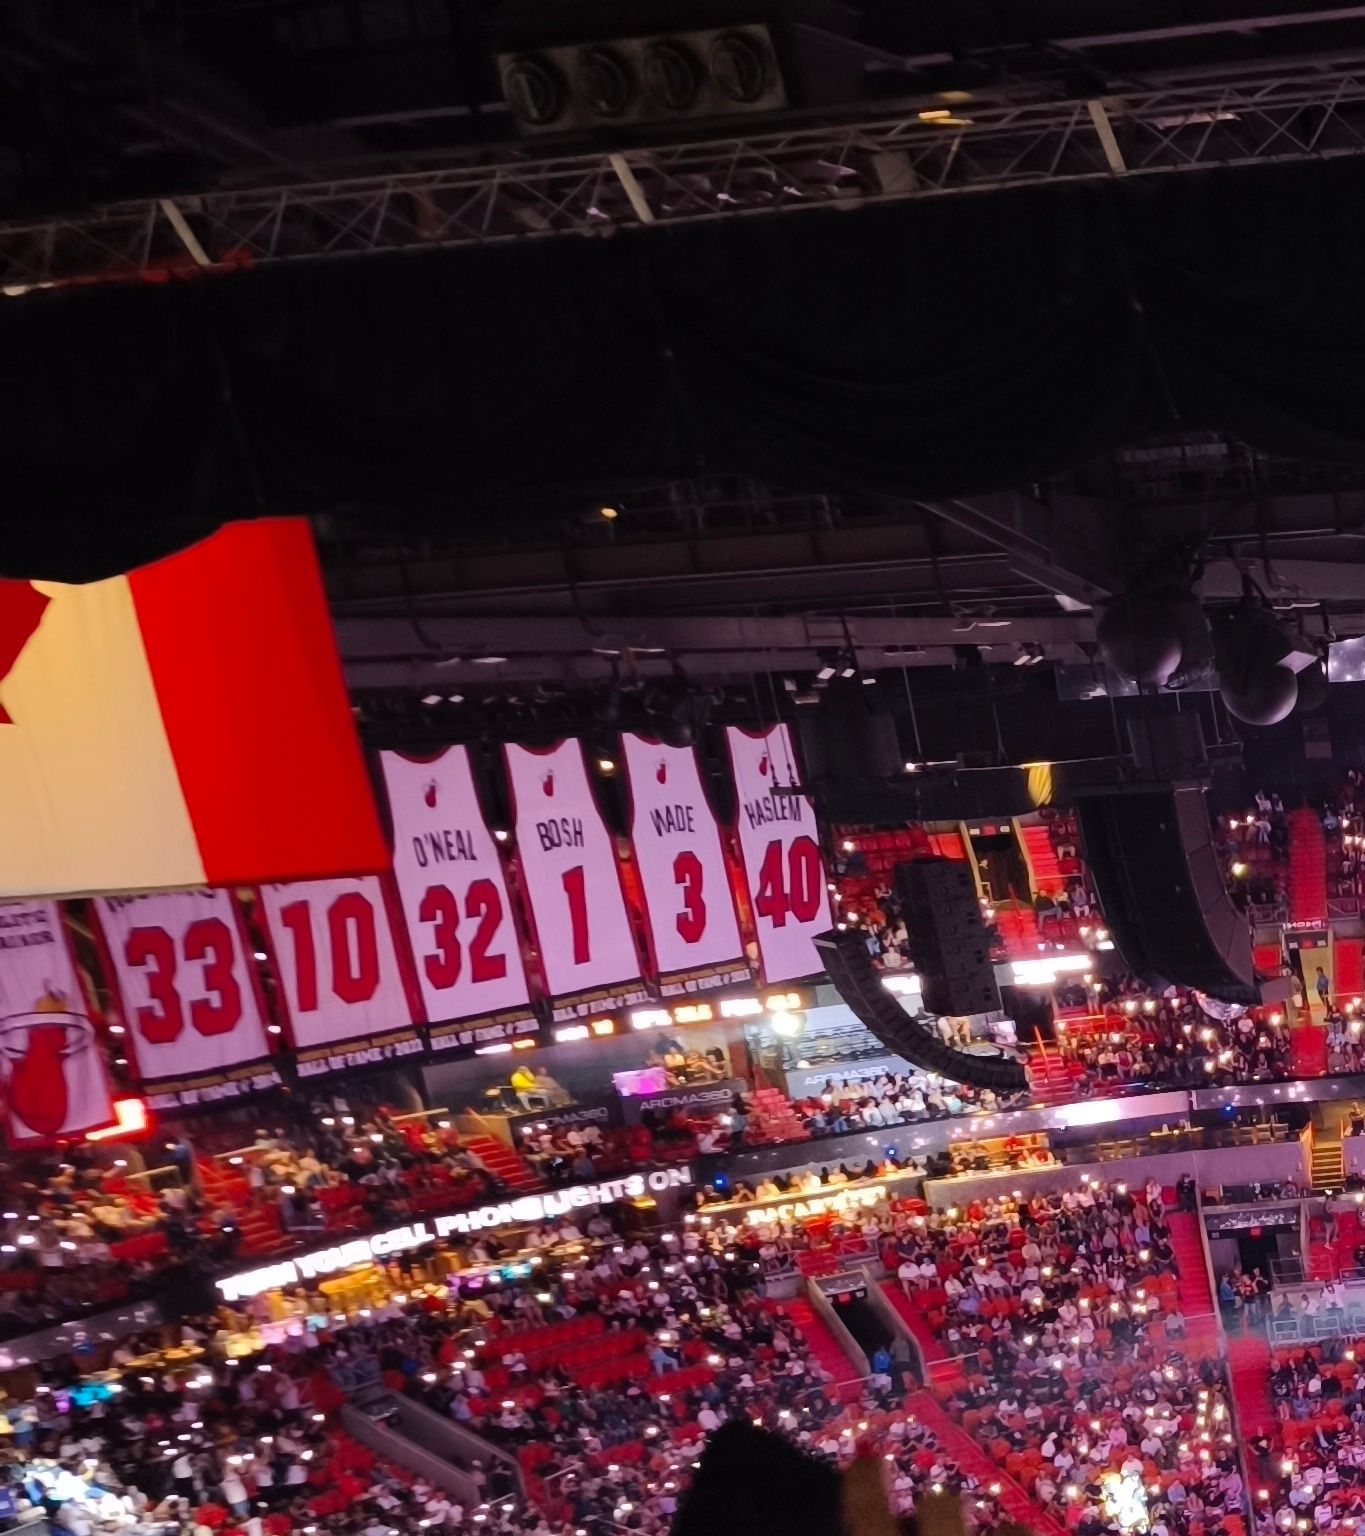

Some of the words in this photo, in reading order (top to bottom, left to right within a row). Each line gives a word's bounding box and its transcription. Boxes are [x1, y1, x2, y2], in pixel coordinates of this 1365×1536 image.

[412, 829, 478, 868] O'NEAL
[535, 817, 585, 852] BOSH
[649, 803, 696, 837] WADE
[743, 793, 803, 830] HASLEM
[561, 865, 591, 966] 1
[672, 850, 707, 944] 3
[755, 834, 822, 929] 40
[125, 916, 243, 1045] 33
[279, 890, 381, 1013] 10
[417, 877, 508, 991] 32
[639, 1087, 734, 1112] AROMA360
[217, 1263, 297, 1300] TURN
[294, 1238, 374, 1278] YOUR
[370, 1221, 436, 1256] CELL
[434, 1194, 543, 1238] PHONE
[543, 1173, 645, 1217] LIGHTS
[648, 1165, 692, 1192] ON
